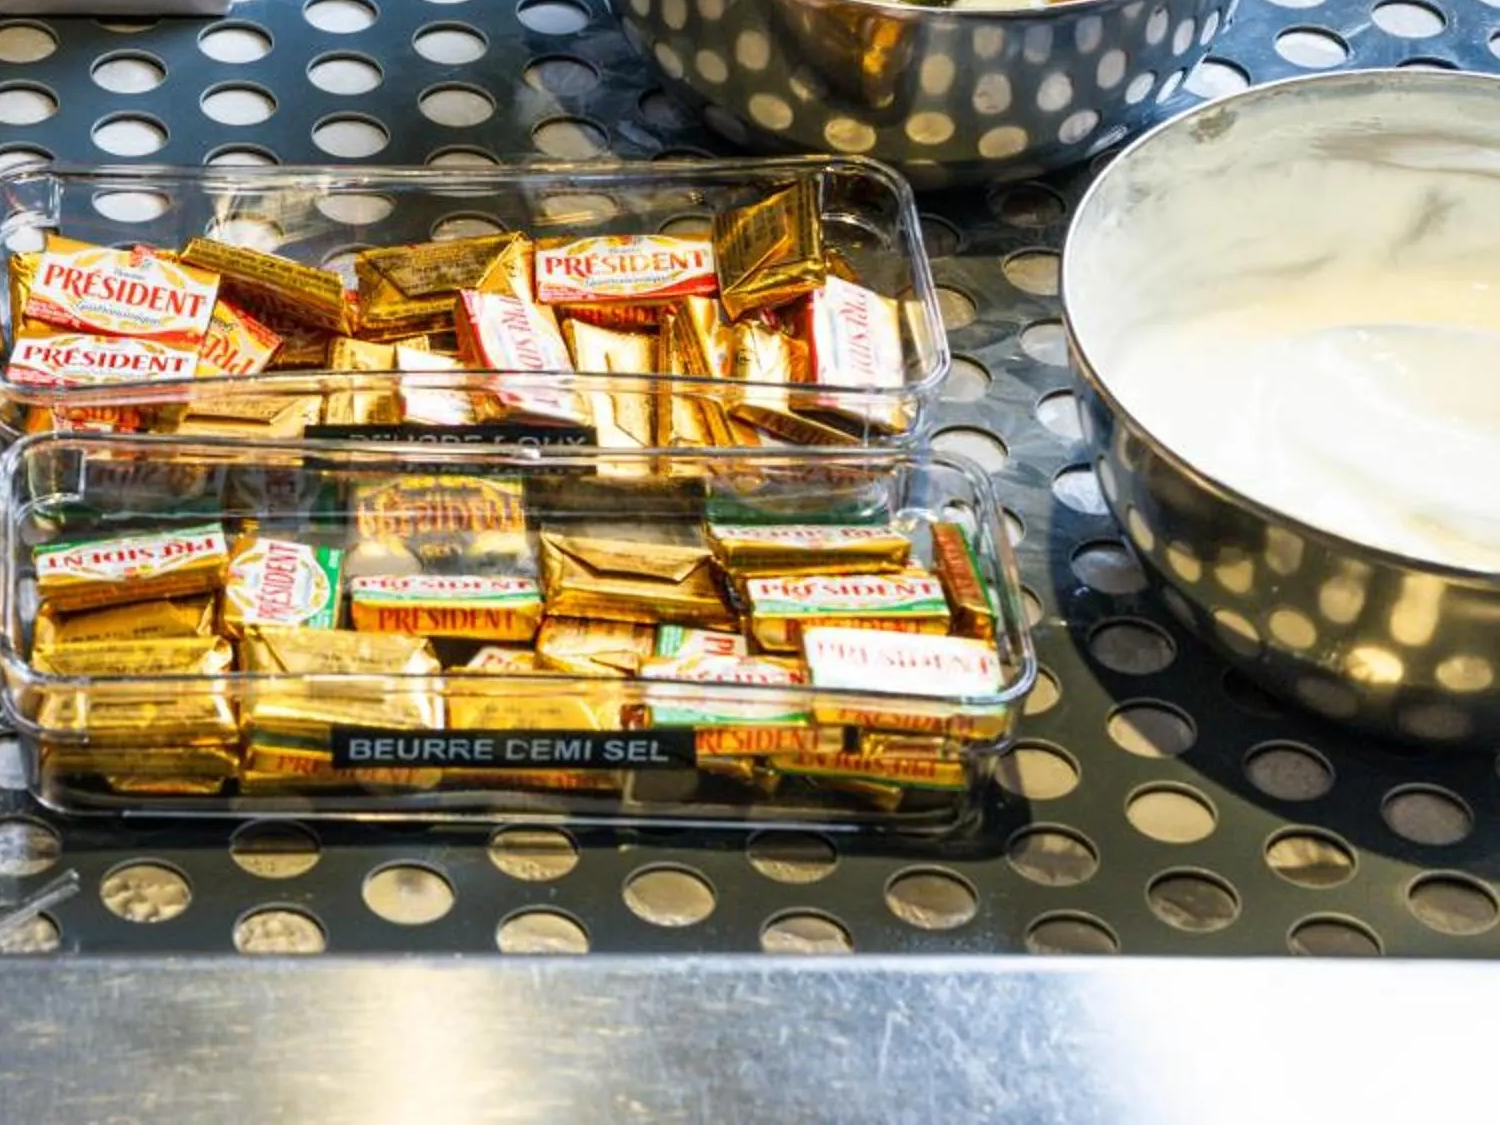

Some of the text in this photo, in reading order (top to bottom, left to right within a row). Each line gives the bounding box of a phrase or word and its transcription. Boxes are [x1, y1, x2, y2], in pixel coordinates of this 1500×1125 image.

[544, 250, 707, 279] PRÉSIDENT
[42, 263, 207, 318] PRÉSIDENT
[22, 344, 190, 373] PRÉSIDENT
[348, 738, 670, 763] BEURRE DEMI SEL
